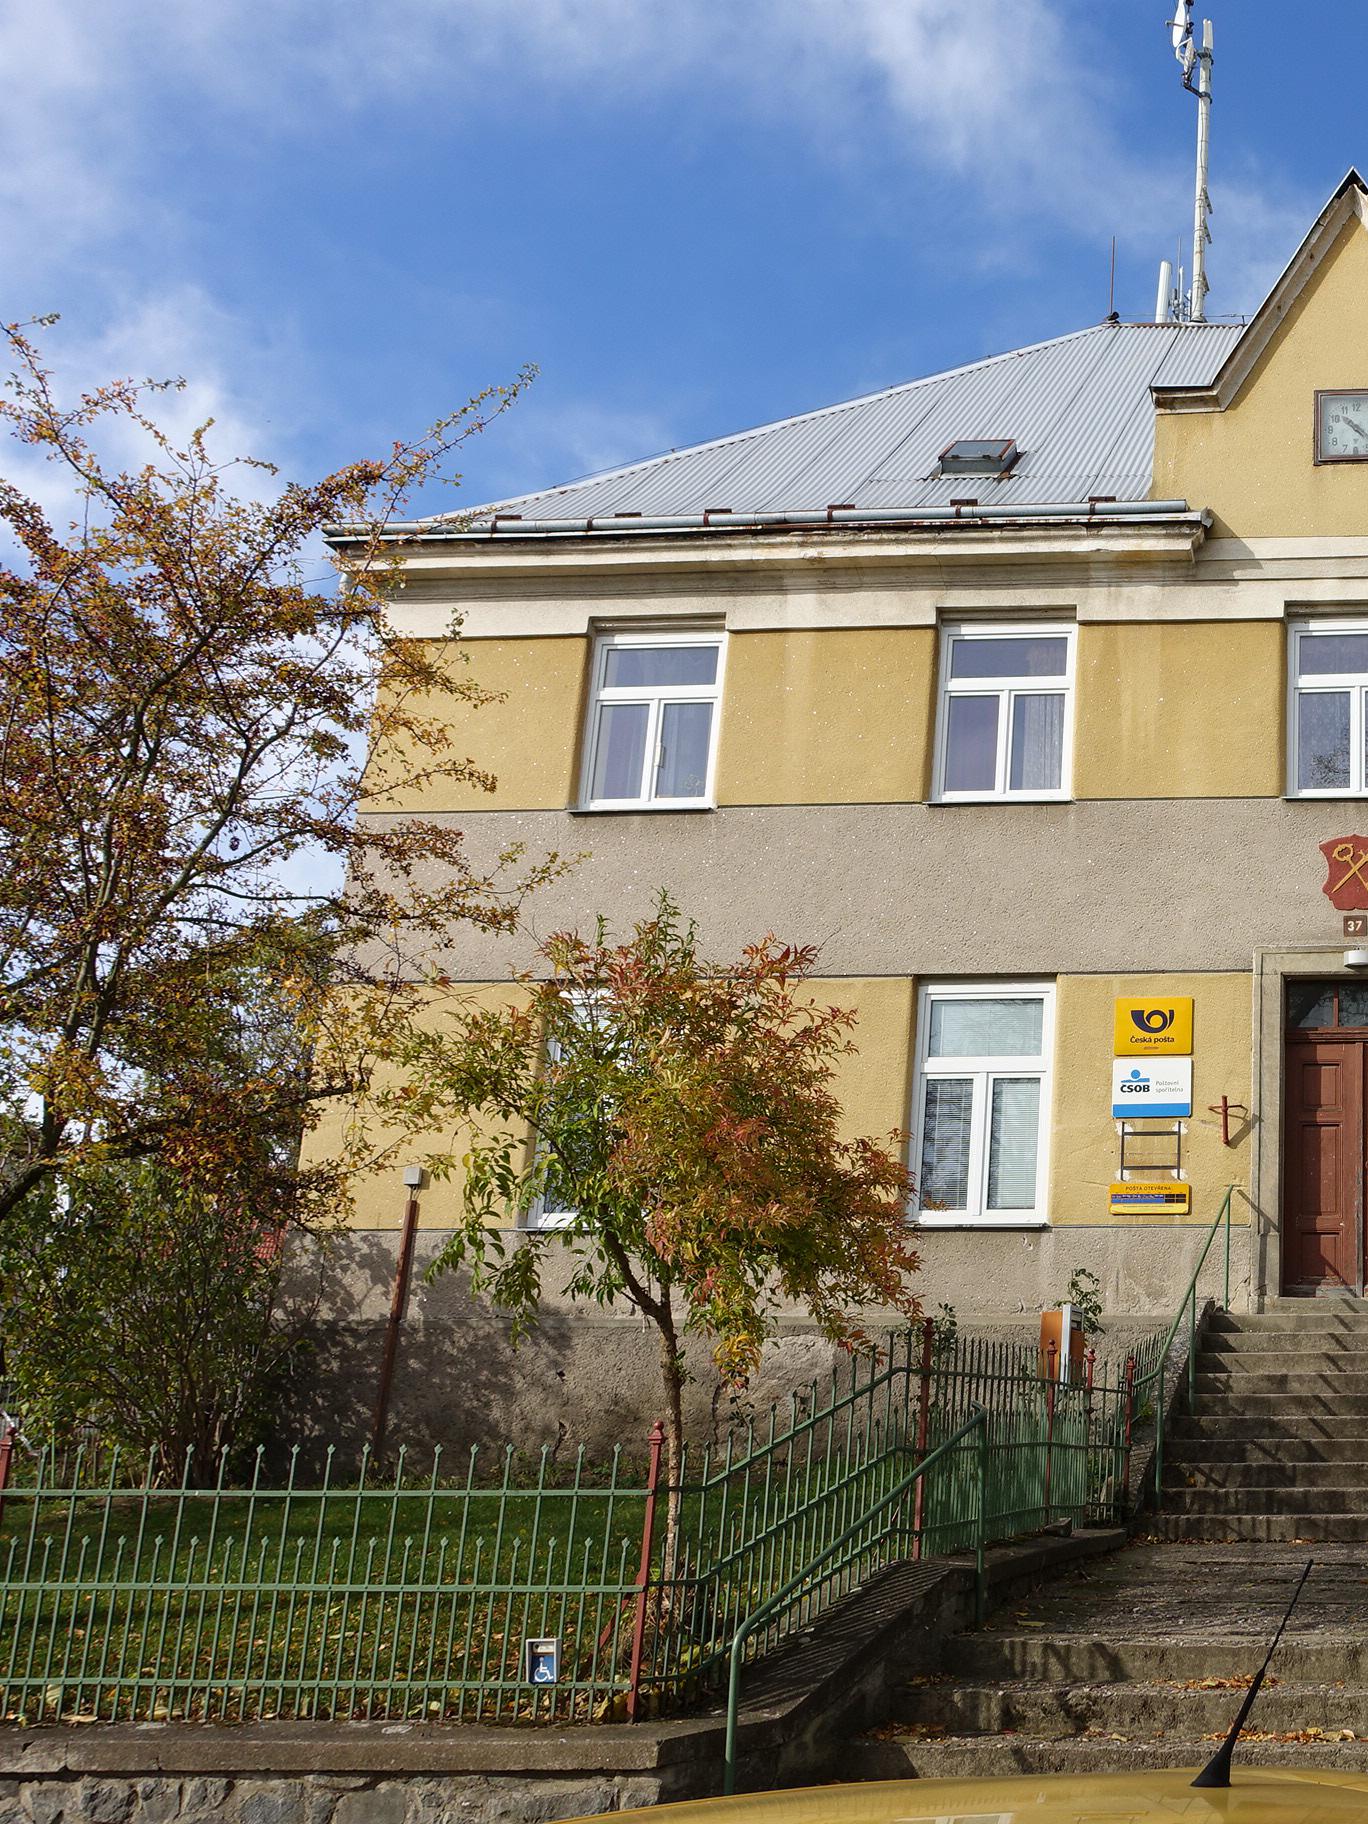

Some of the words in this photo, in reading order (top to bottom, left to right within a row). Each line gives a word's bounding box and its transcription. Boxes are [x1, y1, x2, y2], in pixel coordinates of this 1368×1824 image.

[1341, 406, 1348, 415] 11
[1352, 403, 1360, 411] 12
[1331, 415, 1340, 423] 10
[1328, 426, 1333, 434] 9
[1332, 437, 1338, 446] 8
[1342, 444, 1348, 453] 7
[1347, 920, 1362, 931] 37
[1153, 1036, 1174, 1044] pošta
[1120, 1084, 1150, 1093] ČSOB
